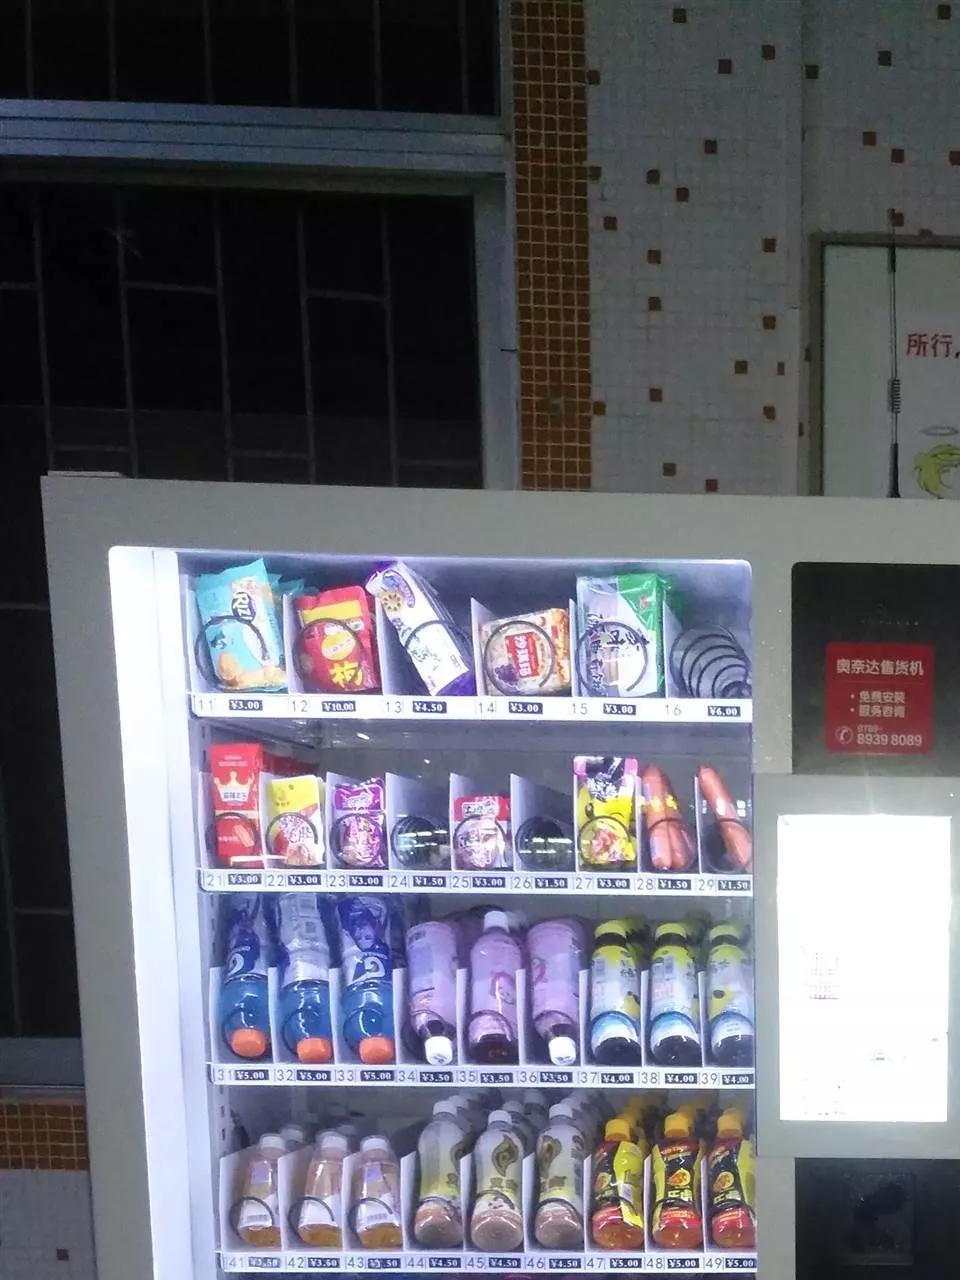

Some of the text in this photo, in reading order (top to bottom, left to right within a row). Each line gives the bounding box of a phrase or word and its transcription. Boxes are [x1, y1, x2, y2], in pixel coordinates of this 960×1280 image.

[836, 659, 924, 675] 奥奈达售货机
[230, 701, 260, 710] ¥3.00
[323, 702, 355, 711] ¥10.00
[414, 702, 444, 712] ¥4.50
[478, 703, 539, 714] 14 ¥3.00
[572, 704, 634, 715] 15 ¥3.00
[709, 707, 738, 716] ¥6.00
[857, 734, 922, 746] 8939 8089
[267, 875, 319, 886] 22 ¥3.00
[329, 876, 379, 887] 23 ¥3.00
[391, 876, 444, 887] 24 ¥1.50
[453, 877, 503, 888] 25 ¥3.00
[514, 879, 566, 889] 26 ¥1.50
[575, 879, 628, 890] 27 ¥3.00
[637, 880, 688, 890] 28 ¥1.50
[698, 880, 748, 891] 29 ¥1.50
[236, 1071, 266, 1080] ¥5.00
[277, 1070, 328, 1080] 32 ¥5.00
[338, 1070, 392, 1080] 33 ¥5.00
[459, 1071, 475, 1081] 35
[520, 1073, 536, 1083] 36
[581, 1073, 631, 1083] 37 ¥4.00
[641, 1073, 695, 1084] 38 ¥4.00
[701, 1073, 717, 1084] 39
[288, 1258, 304, 1268] 42
[348, 1258, 363, 1268] 43
[408, 1258, 459, 1268] 44 ¥4.50
[468, 1258, 518, 1268] 45 ¥4.50
[527, 1258, 578, 1268] 46 ¥4.50
[587, 1258, 639, 1268] 47 ¥5.00
[647, 1258, 697, 1268] 48 ¥5.00
[705, 1258, 754, 1268] 49 ¥5.00
